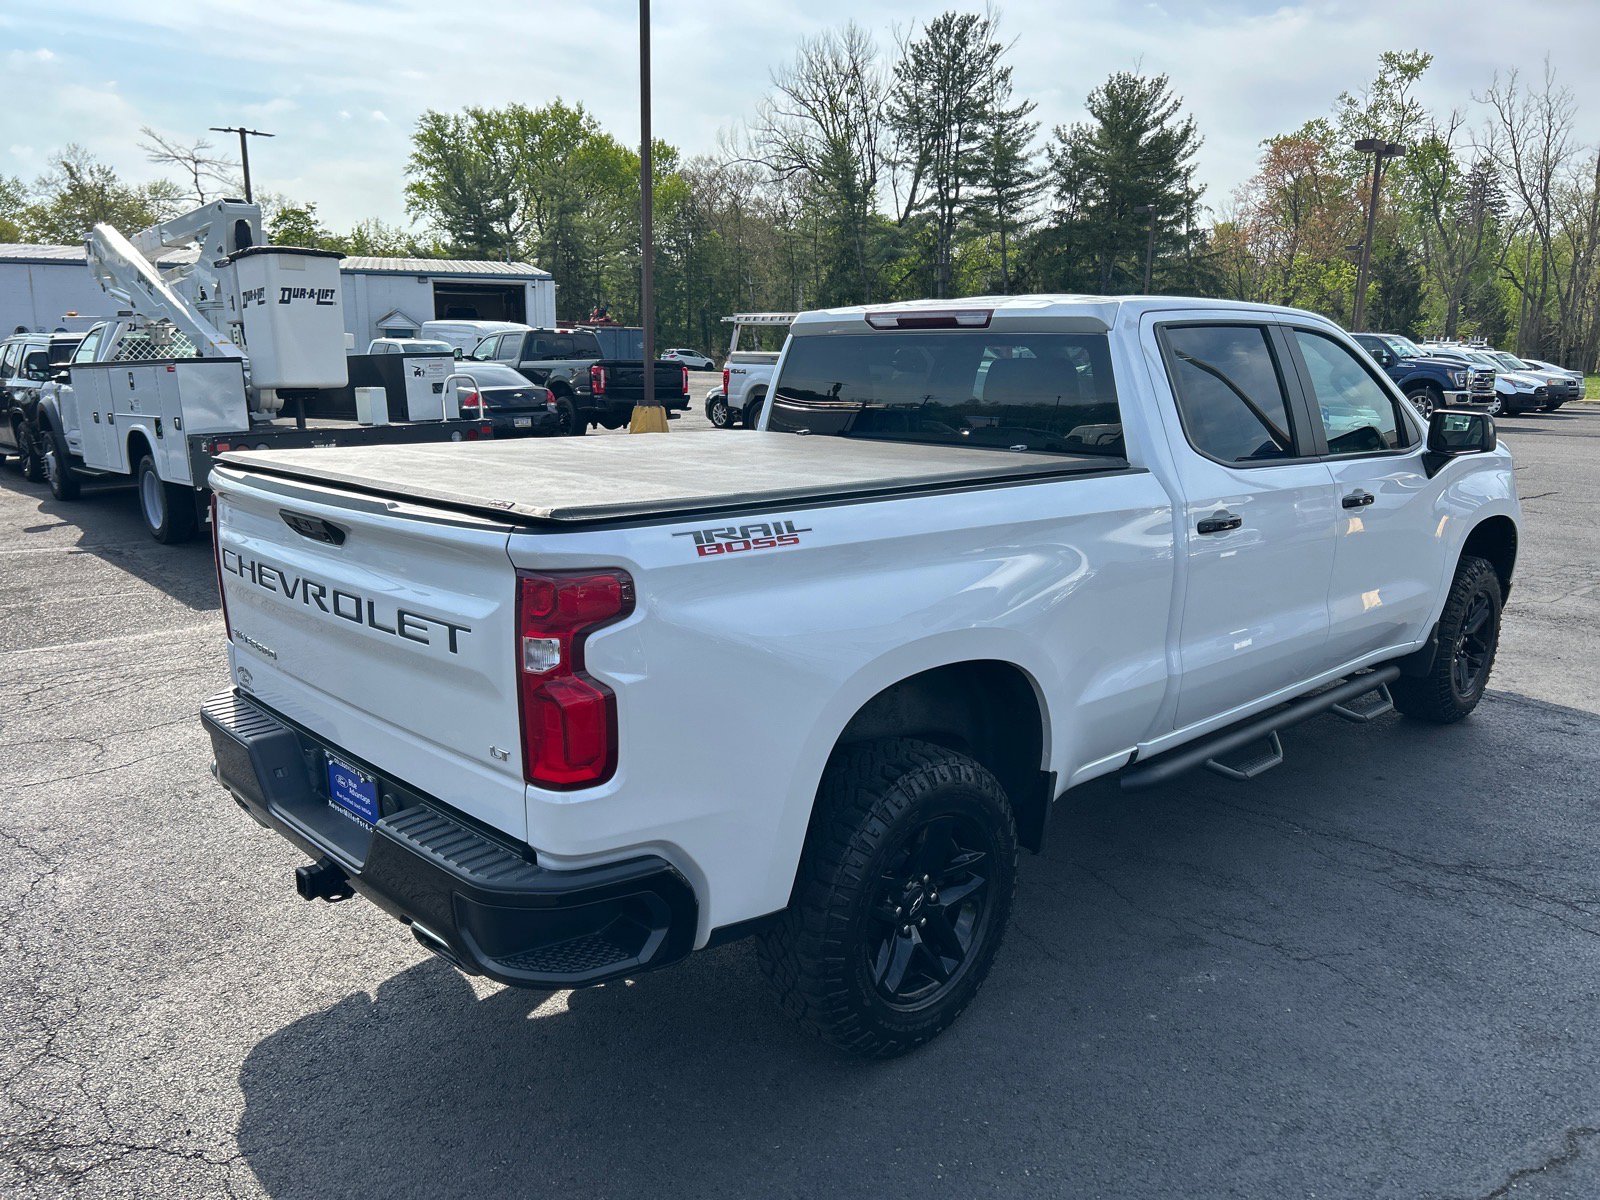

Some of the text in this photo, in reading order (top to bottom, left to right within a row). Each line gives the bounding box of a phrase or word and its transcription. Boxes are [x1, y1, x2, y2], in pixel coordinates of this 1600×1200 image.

[671, 520, 813, 545] TRAIL
[696, 533, 800, 557] BOSS
[221, 547, 472, 655] CHEVROLET
[489, 745, 511, 762] LT
